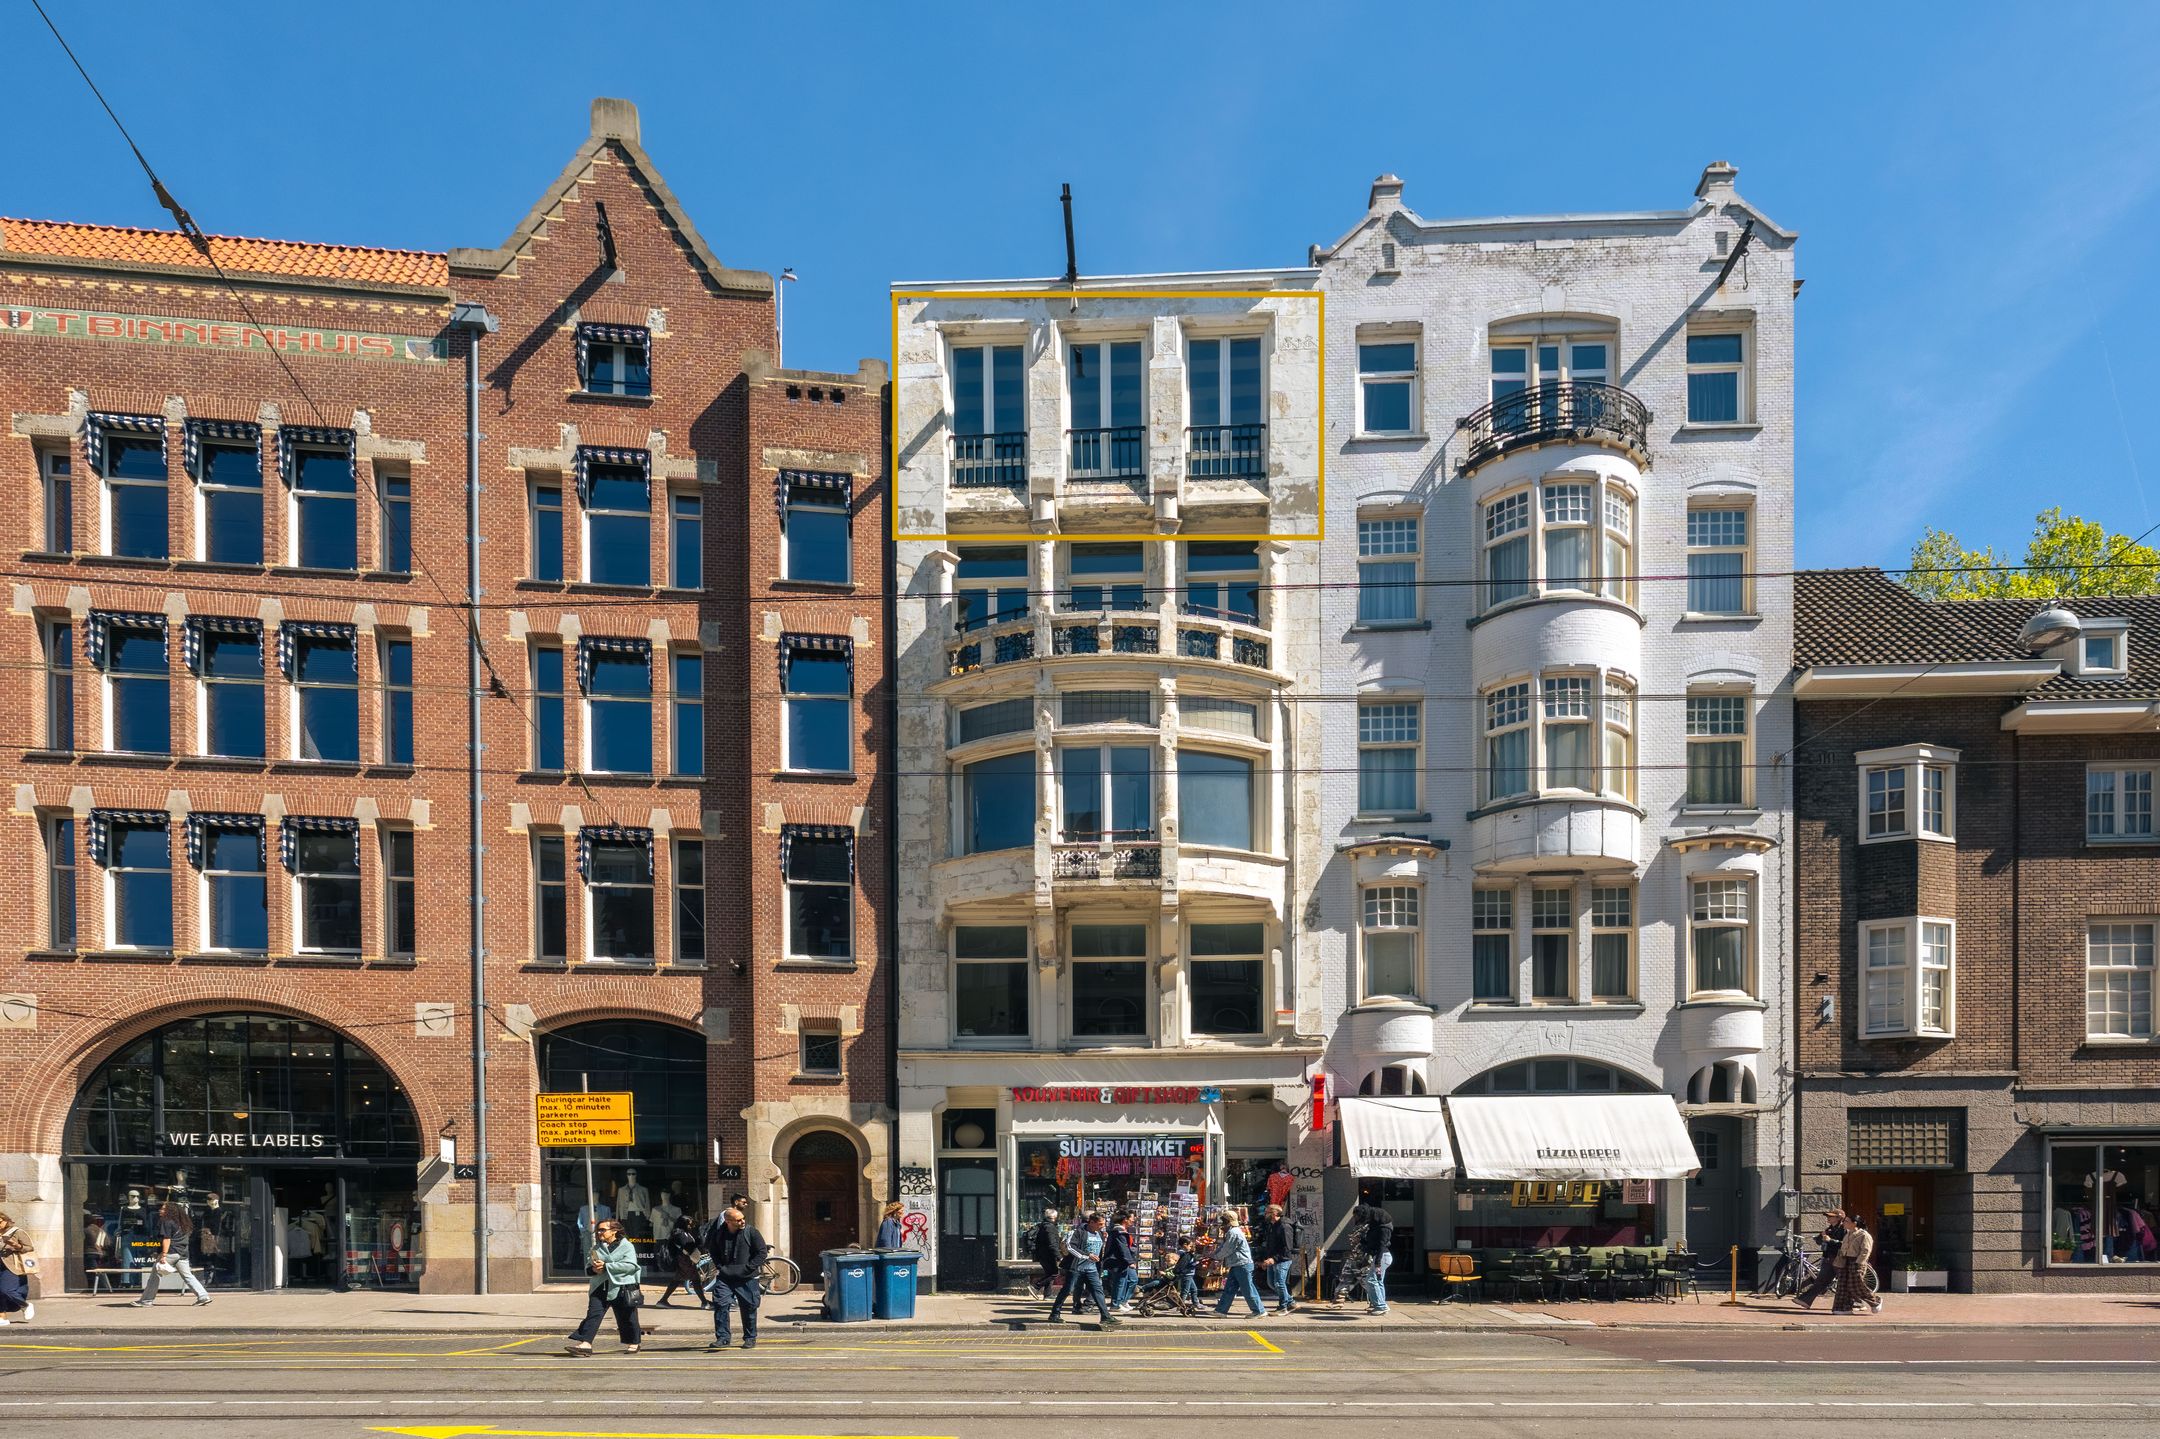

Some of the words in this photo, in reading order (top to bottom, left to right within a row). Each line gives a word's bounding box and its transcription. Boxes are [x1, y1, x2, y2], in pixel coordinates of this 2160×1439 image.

[87, 315, 395, 358] BINNENHUIS
[540, 1096, 585, 1105] Touringcar
[1012, 1086, 1100, 1104] SOUVENIR
[1100, 1087, 1112, 1104] &
[568, 1121, 588, 1129] stop
[564, 1129, 596, 1137] parking
[169, 1133, 201, 1146] WE
[207, 1133, 245, 1147] ARE
[251, 1133, 324, 1147] LABELS
[1059, 1139, 1186, 1157] SUPERMARKET
[1359, 1146, 1399, 1158] pizza
[1536, 1147, 1578, 1159] pizza
